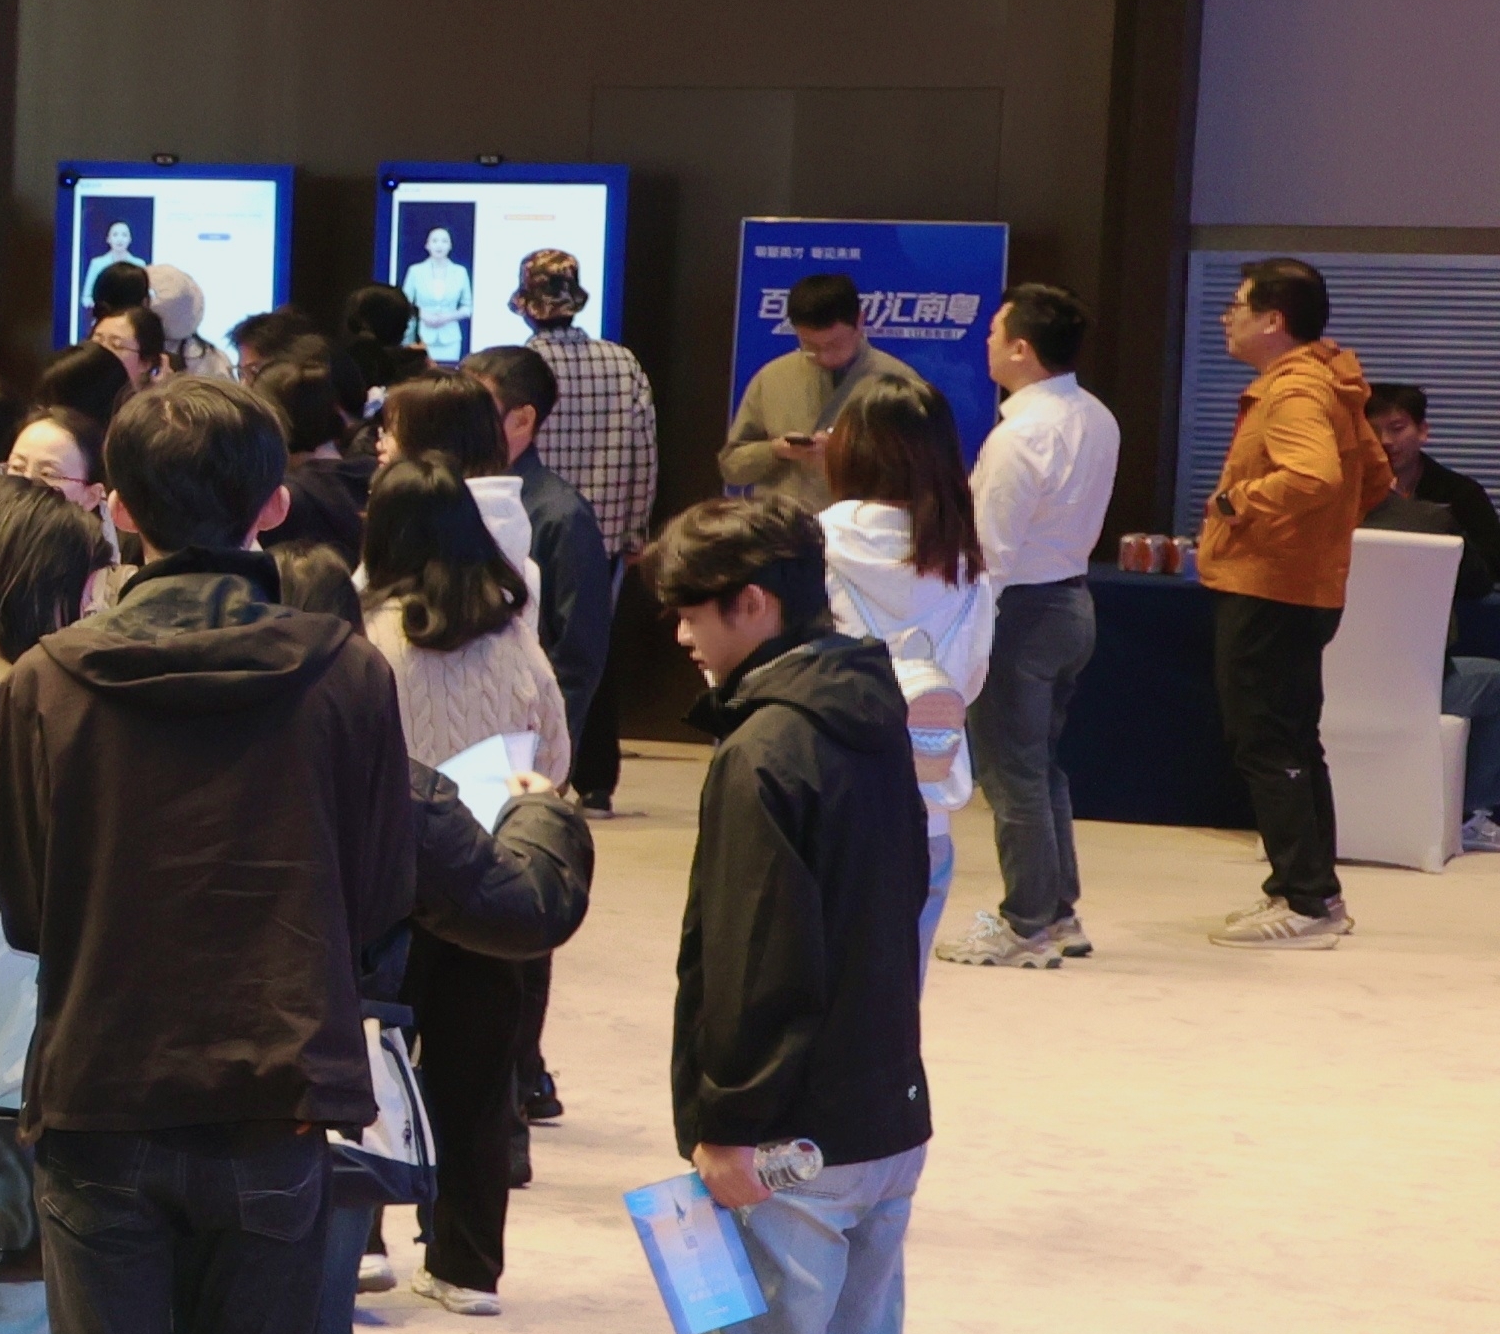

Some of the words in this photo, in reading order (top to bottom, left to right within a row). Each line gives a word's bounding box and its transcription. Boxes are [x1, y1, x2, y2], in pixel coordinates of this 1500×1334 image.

[758, 288, 981, 329] 百才汇南粤
